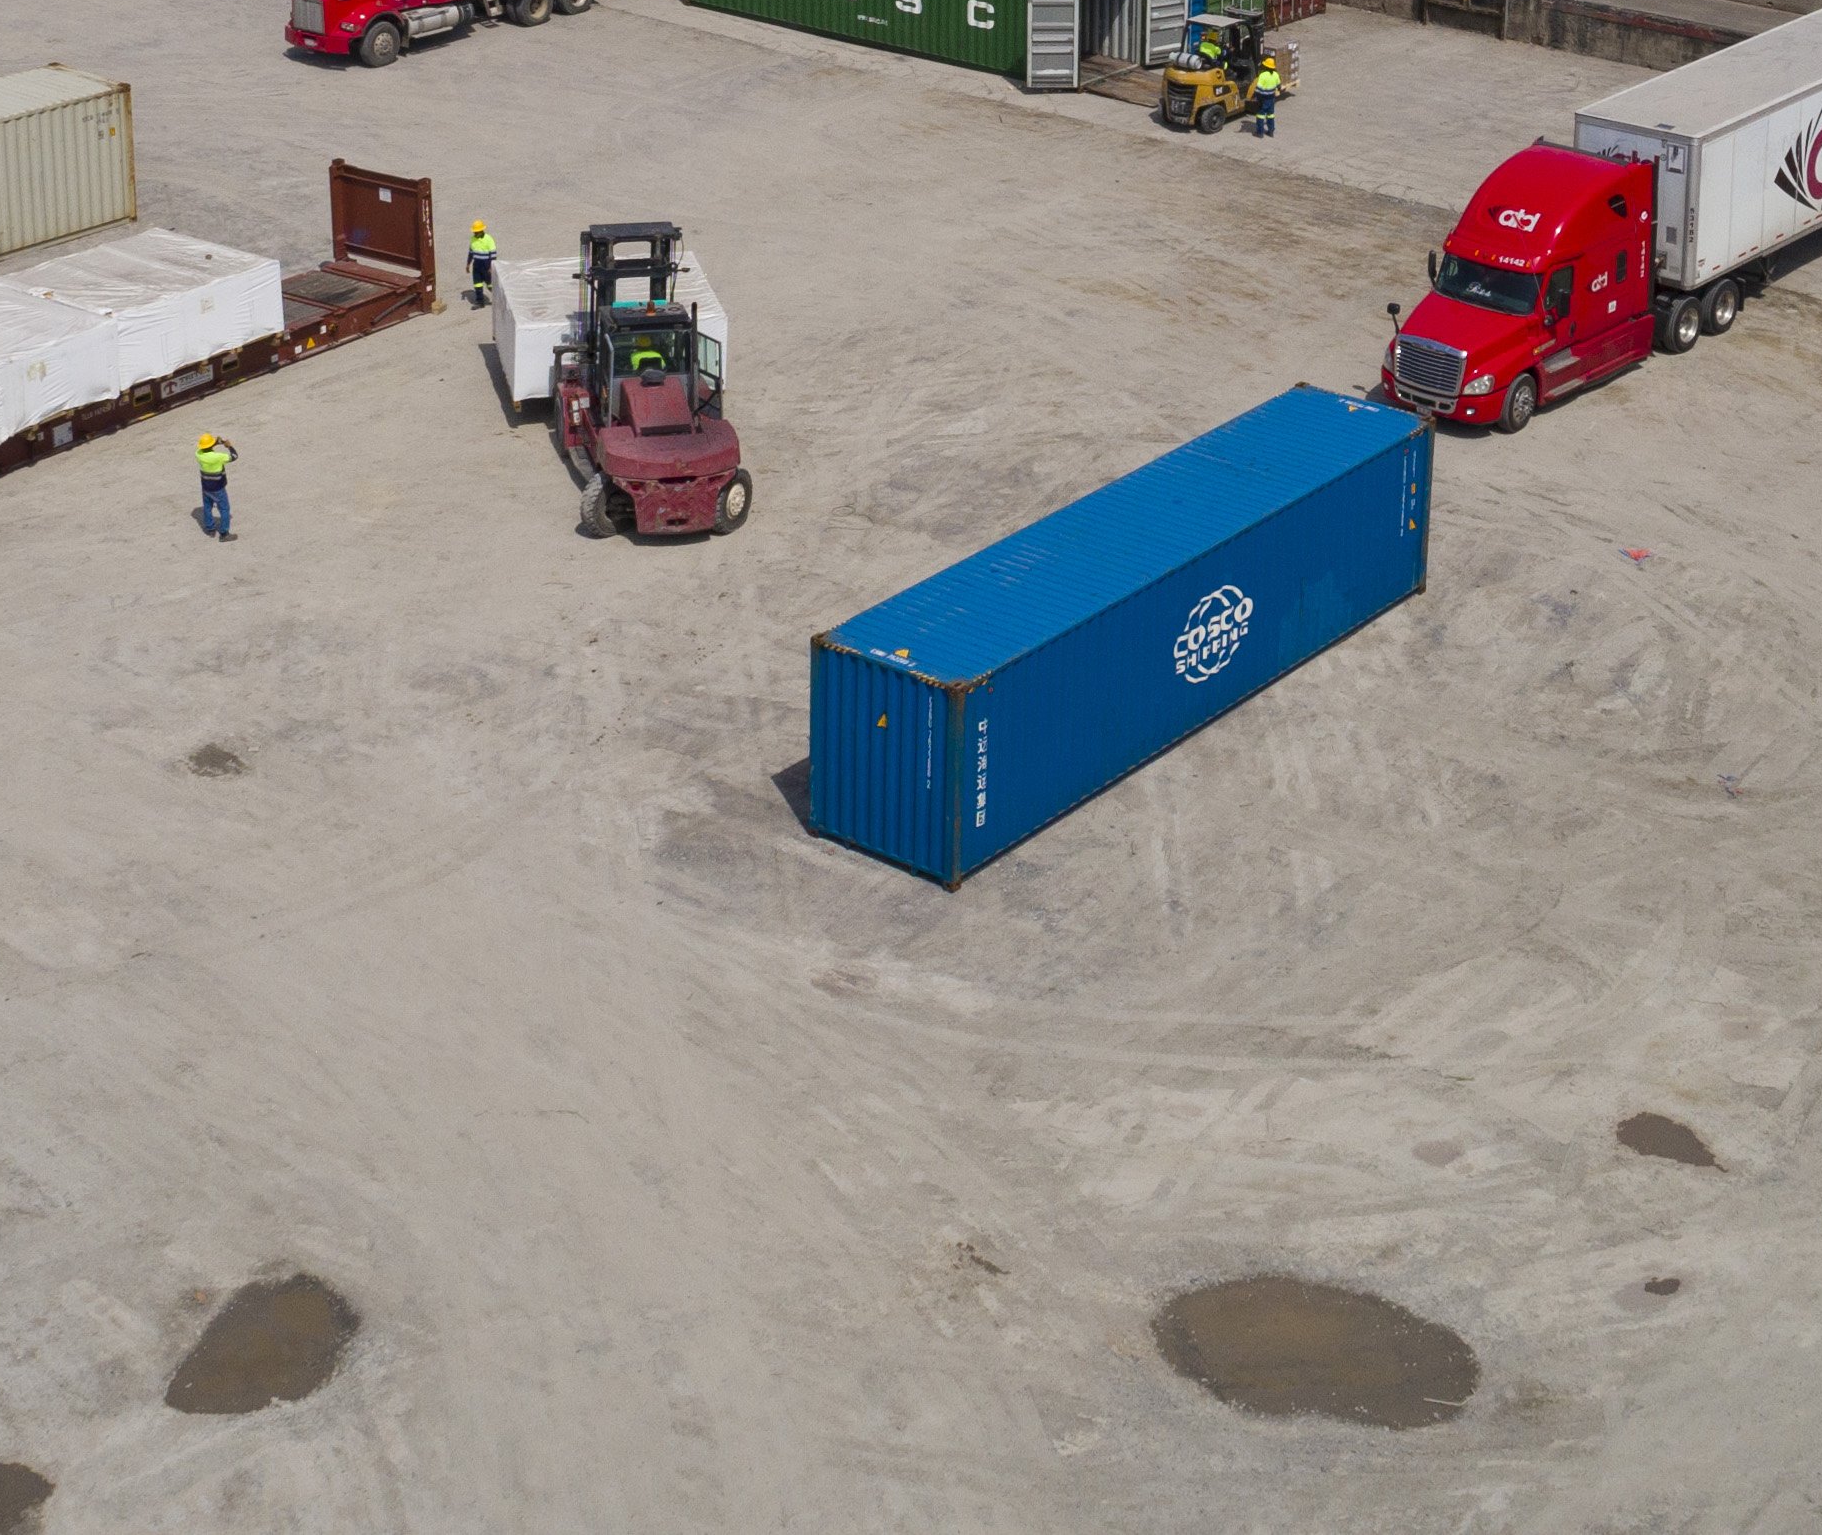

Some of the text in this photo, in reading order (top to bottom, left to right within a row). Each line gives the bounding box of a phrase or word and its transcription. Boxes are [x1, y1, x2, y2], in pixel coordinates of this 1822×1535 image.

[1498, 208, 1542, 233] atd
[1498, 255, 1525, 267] 14142
[1591, 271, 1608, 293] atd
[1173, 597, 1254, 659] COSCO
[1175, 621, 1249, 675] SHIPPING
